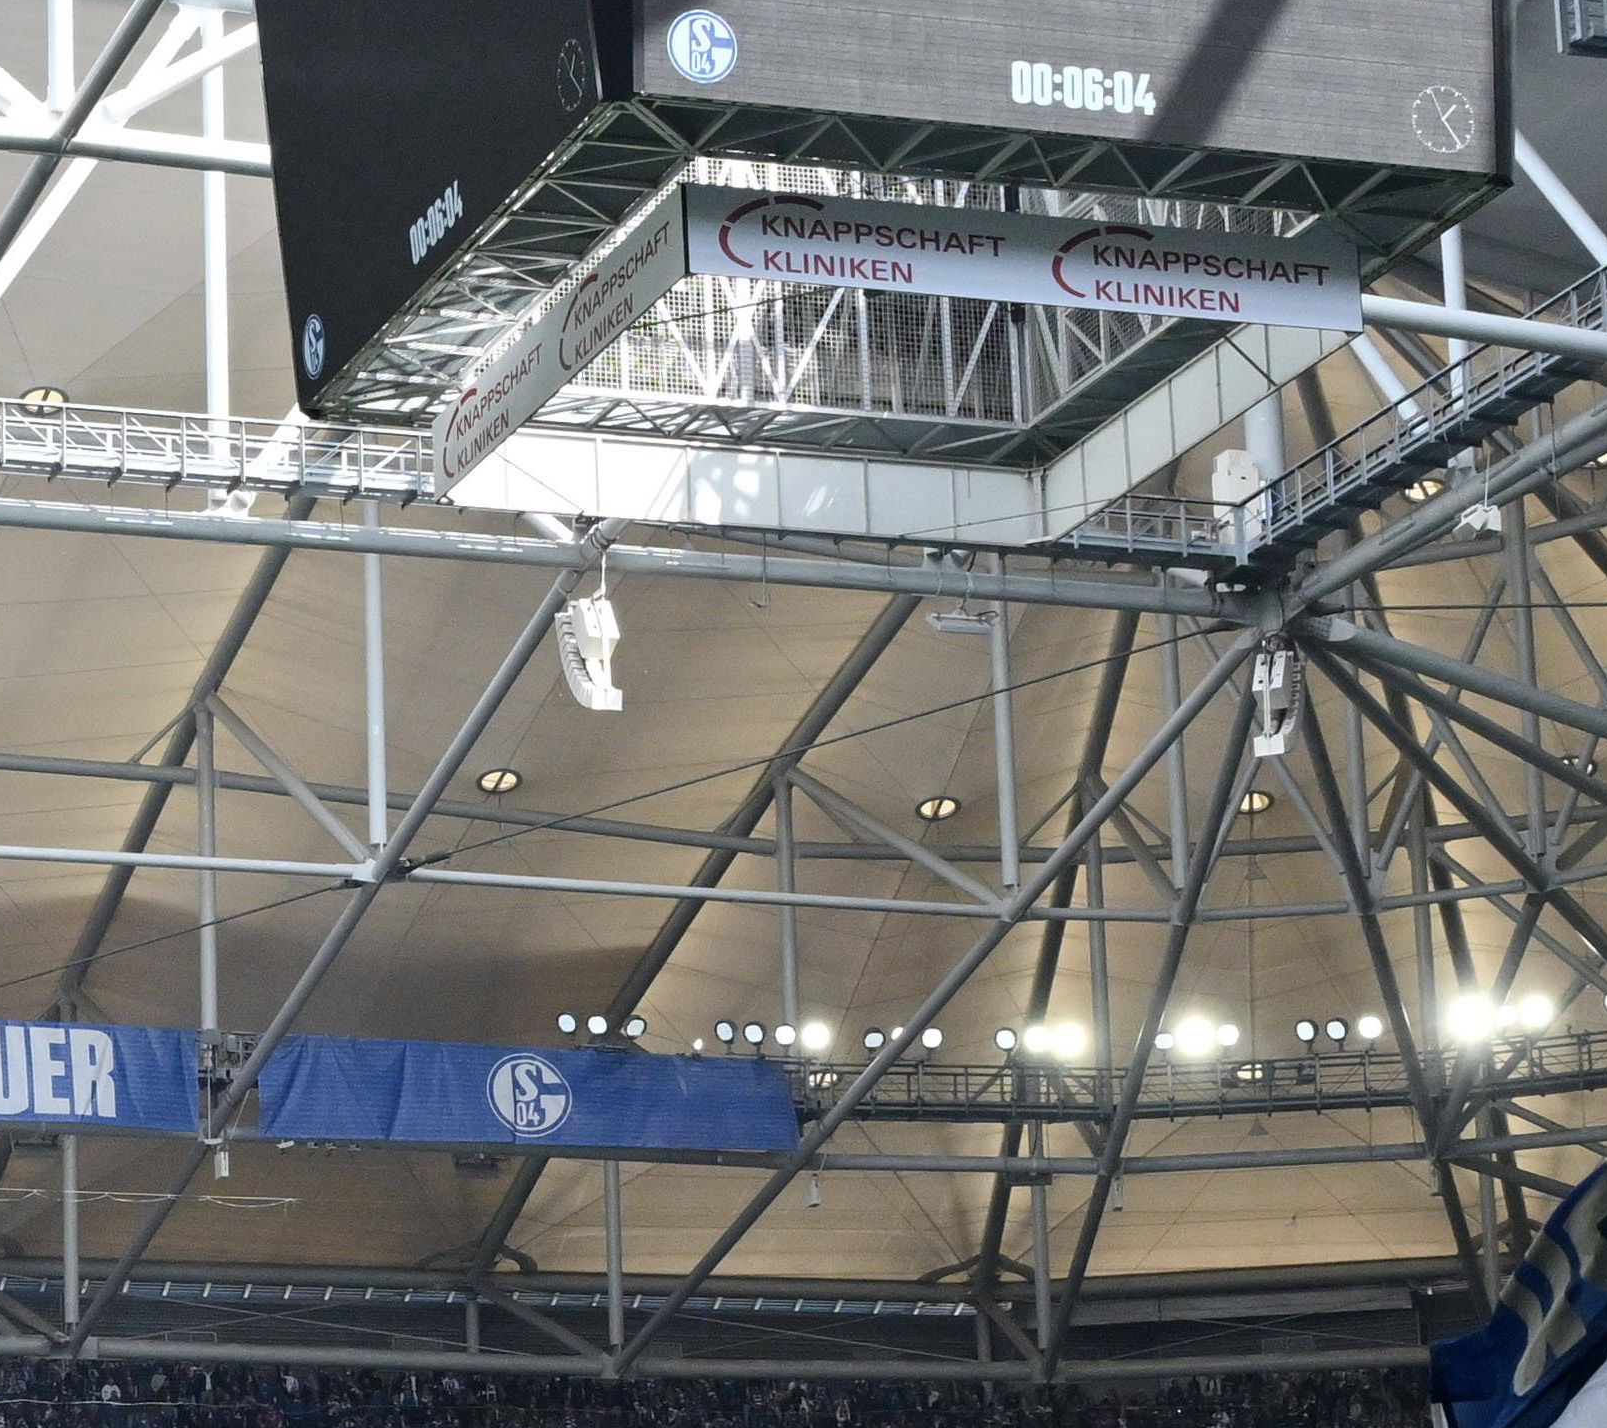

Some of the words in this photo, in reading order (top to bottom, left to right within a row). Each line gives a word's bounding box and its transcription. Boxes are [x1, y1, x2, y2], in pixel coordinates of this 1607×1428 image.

[1011, 60, 1156, 115] 00:06:04
[409, 179, 463, 265] 00:06:04
[761, 214, 1005, 257] KNAPPSCHAFT
[573, 221, 670, 330] KNAPPSCHAFT
[763, 250, 913, 284] KLINIKEN
[1093, 244, 1329, 286] KNAPPSCHAFT
[1095, 279, 1239, 313] KLINIKEN
[573, 292, 634, 364] KLINIKEN
[456, 342, 542, 441] KNAPPSCHAFT
[456, 408, 510, 474] KLINIKEN
